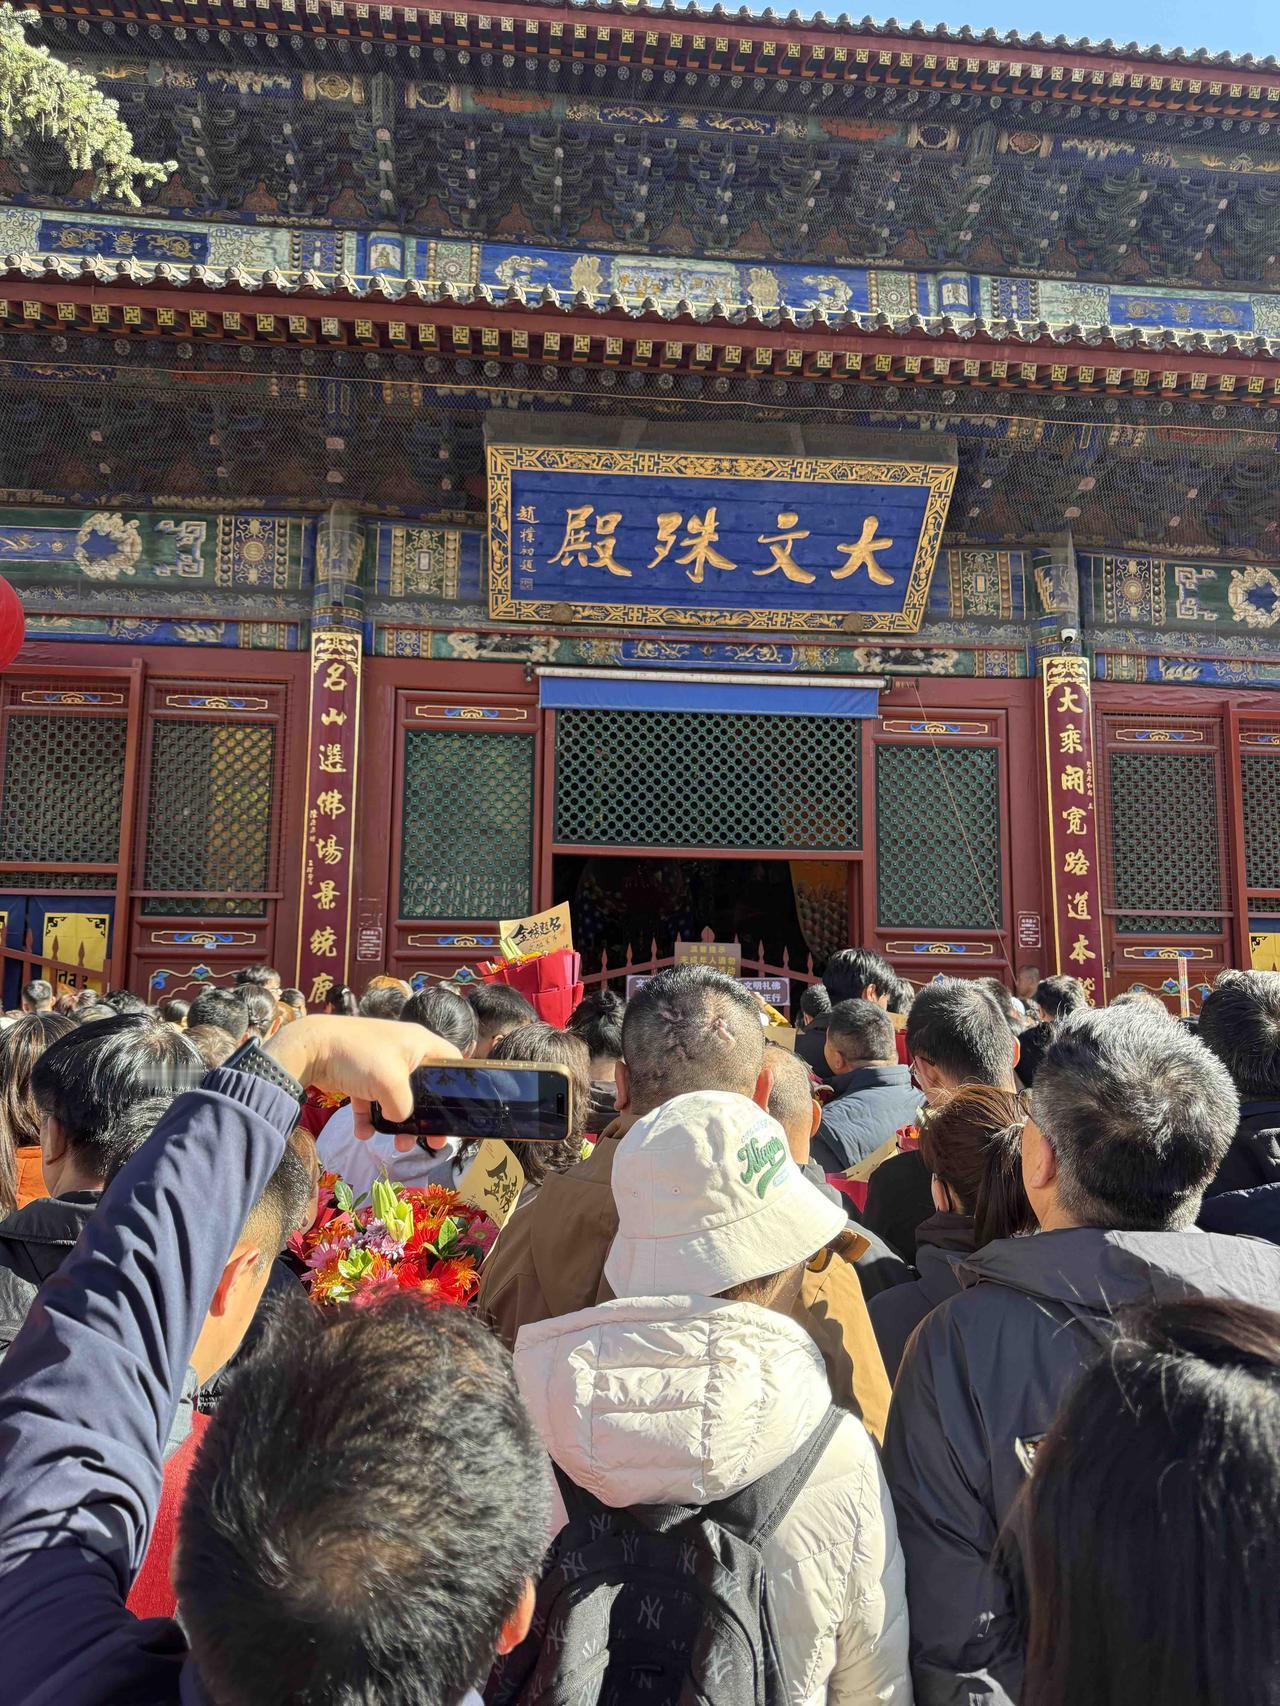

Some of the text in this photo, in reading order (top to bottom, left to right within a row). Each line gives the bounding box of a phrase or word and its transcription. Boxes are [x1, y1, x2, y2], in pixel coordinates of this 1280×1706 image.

[547, 504, 895, 586] 大文殊殿
[744, 981, 781, 991] 文明礼佛
[637, 1596, 664, 1630] NY
